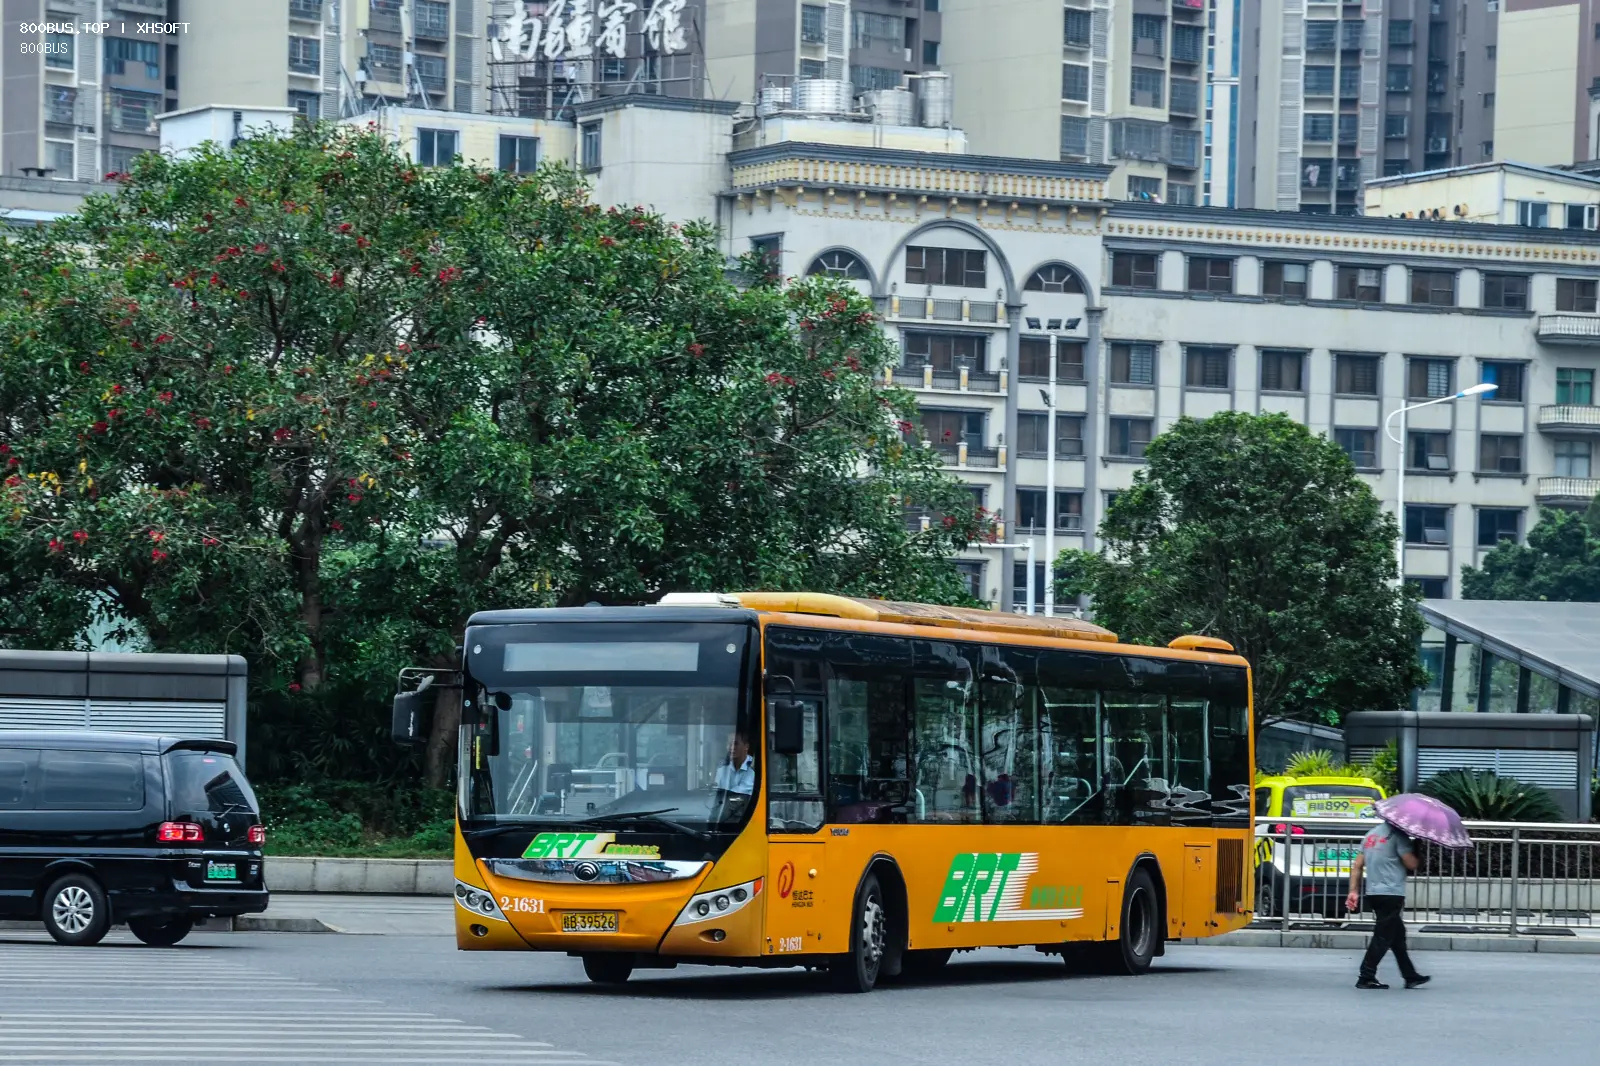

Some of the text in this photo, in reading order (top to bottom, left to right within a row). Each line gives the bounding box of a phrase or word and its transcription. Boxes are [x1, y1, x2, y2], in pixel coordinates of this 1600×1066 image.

[524, 833, 598, 858] BRT
[931, 852, 1023, 923] BRT
[501, 896, 546, 914] 2-1631
[779, 936, 803, 952] 2-1631
